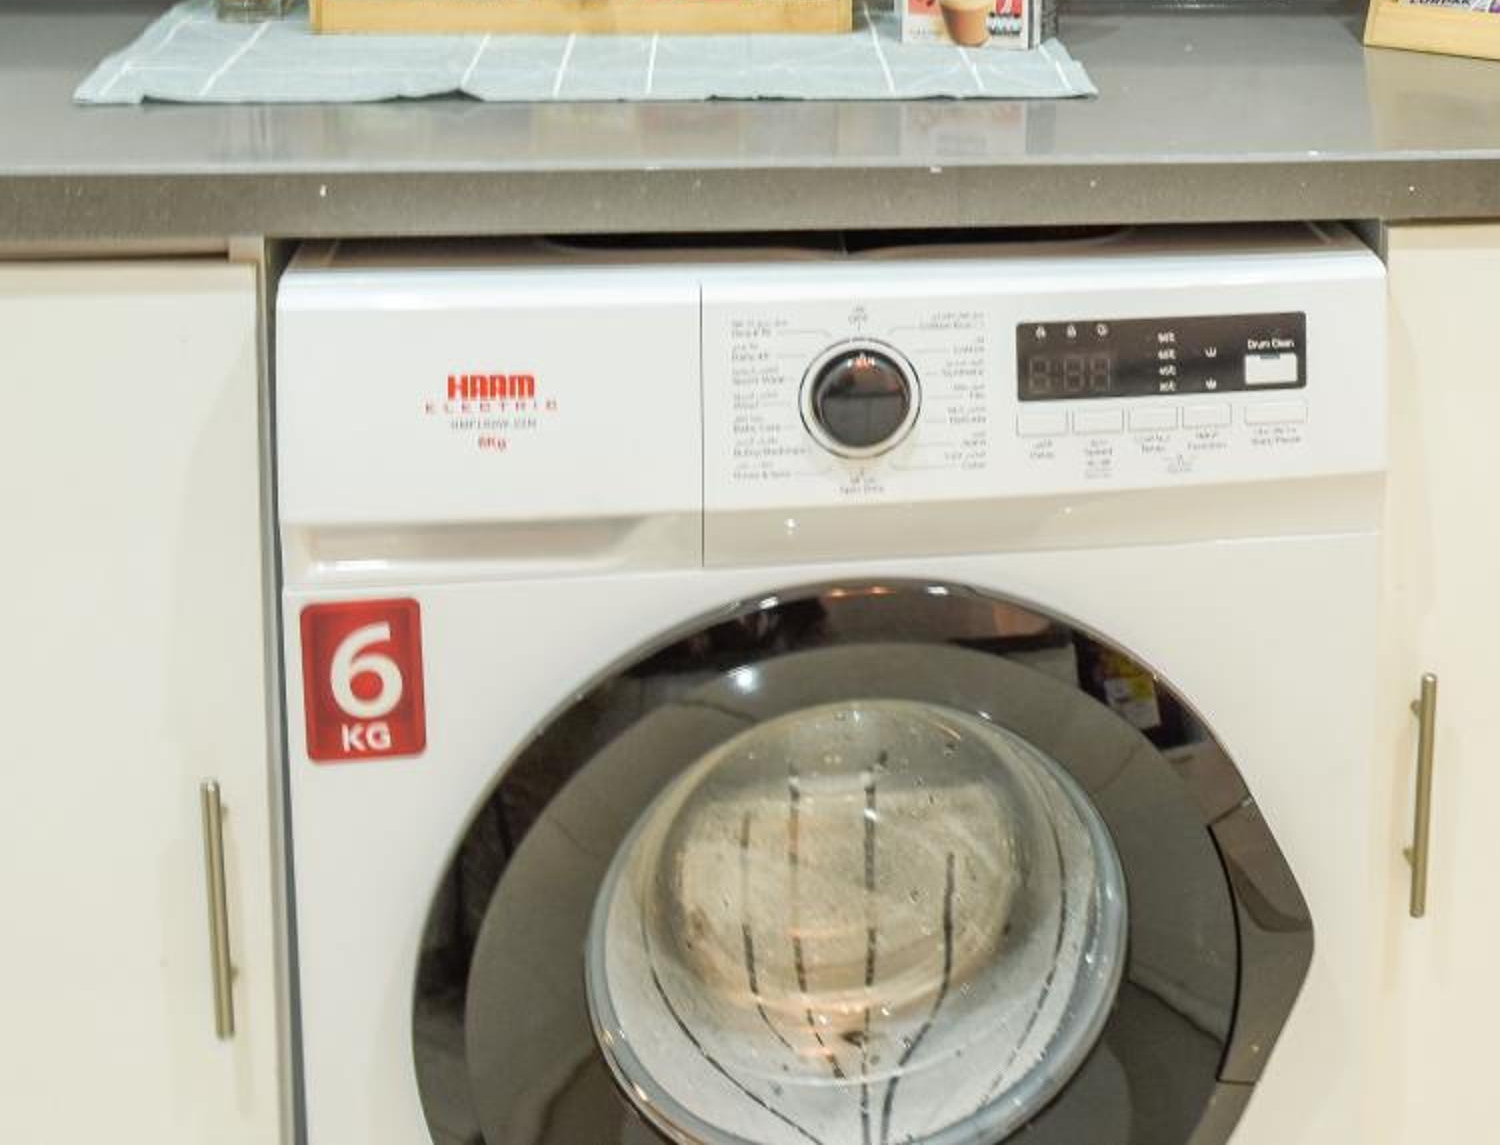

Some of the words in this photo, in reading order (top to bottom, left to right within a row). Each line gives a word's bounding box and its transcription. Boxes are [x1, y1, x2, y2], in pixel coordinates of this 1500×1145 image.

[448, 374, 535, 400] HAAM
[330, 621, 403, 719] 6
[341, 721, 392, 752] KG
